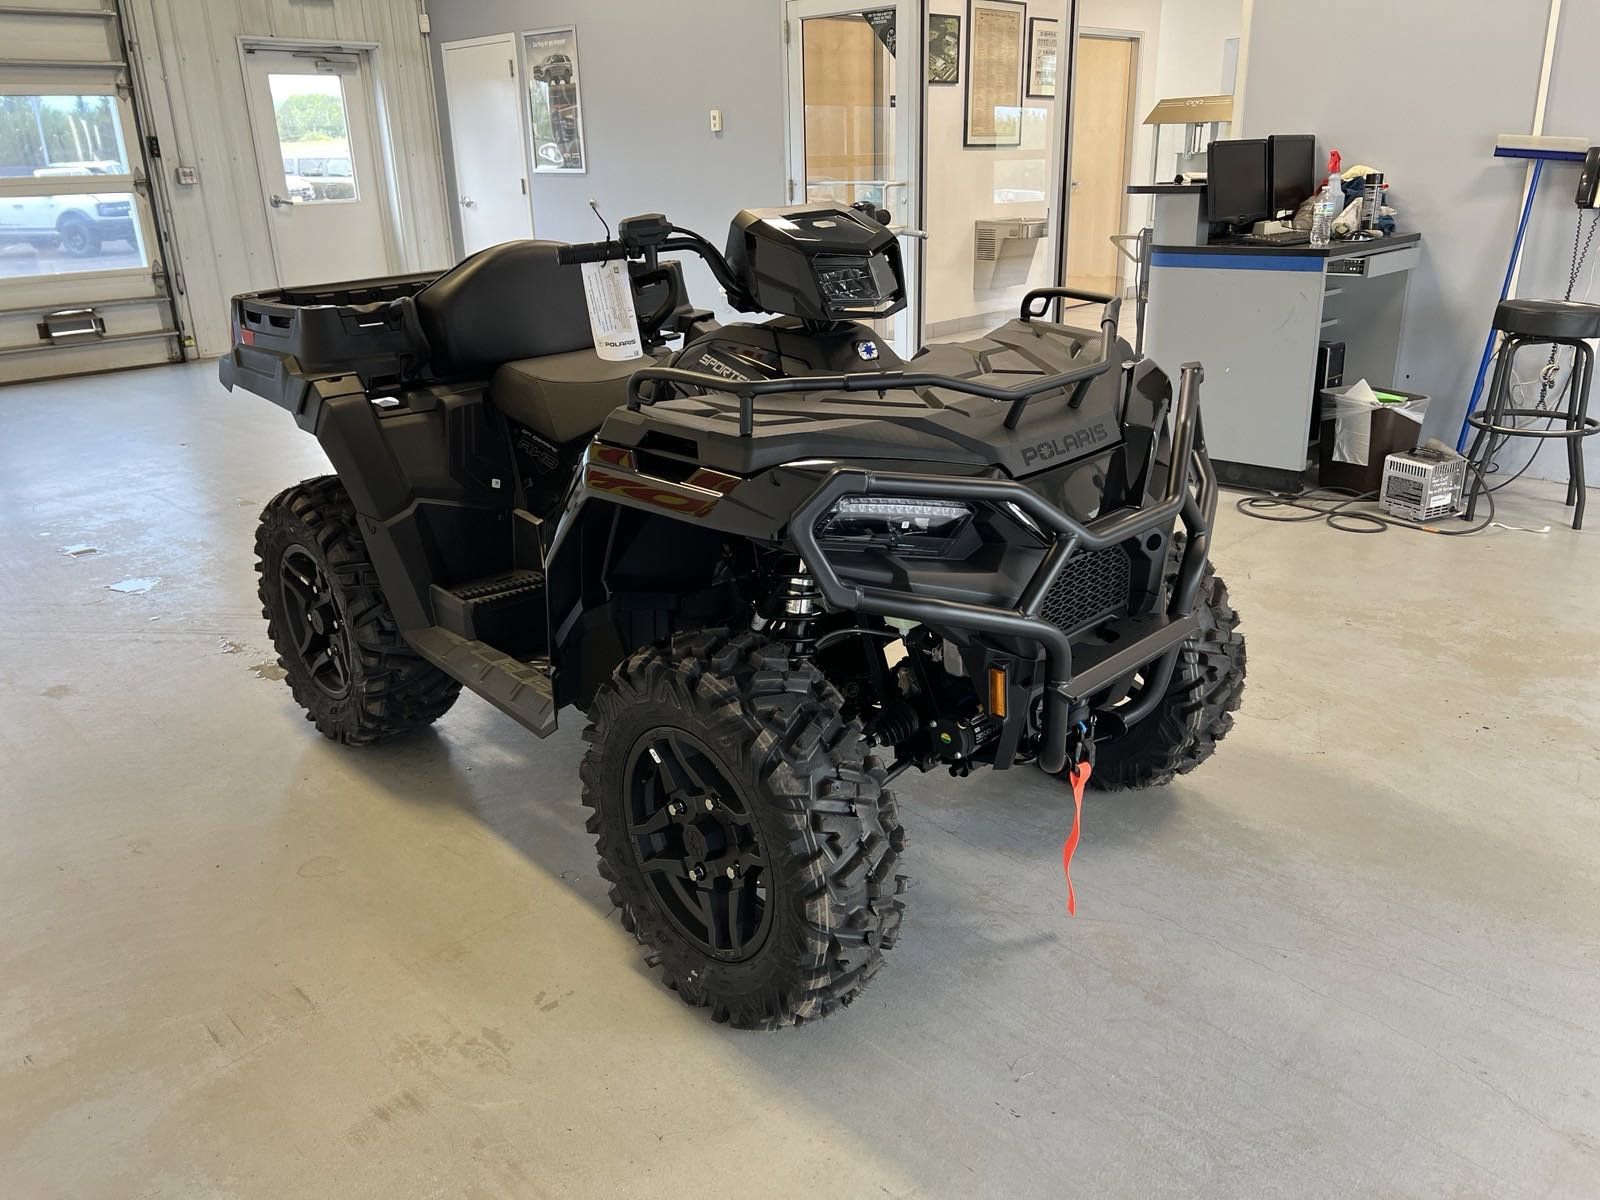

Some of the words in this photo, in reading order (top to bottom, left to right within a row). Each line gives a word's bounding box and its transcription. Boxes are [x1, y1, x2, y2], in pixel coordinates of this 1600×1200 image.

[605, 339, 636, 347] POLARIS
[699, 353, 750, 381] SPORTS
[1021, 423, 1108, 466] POLARIS
